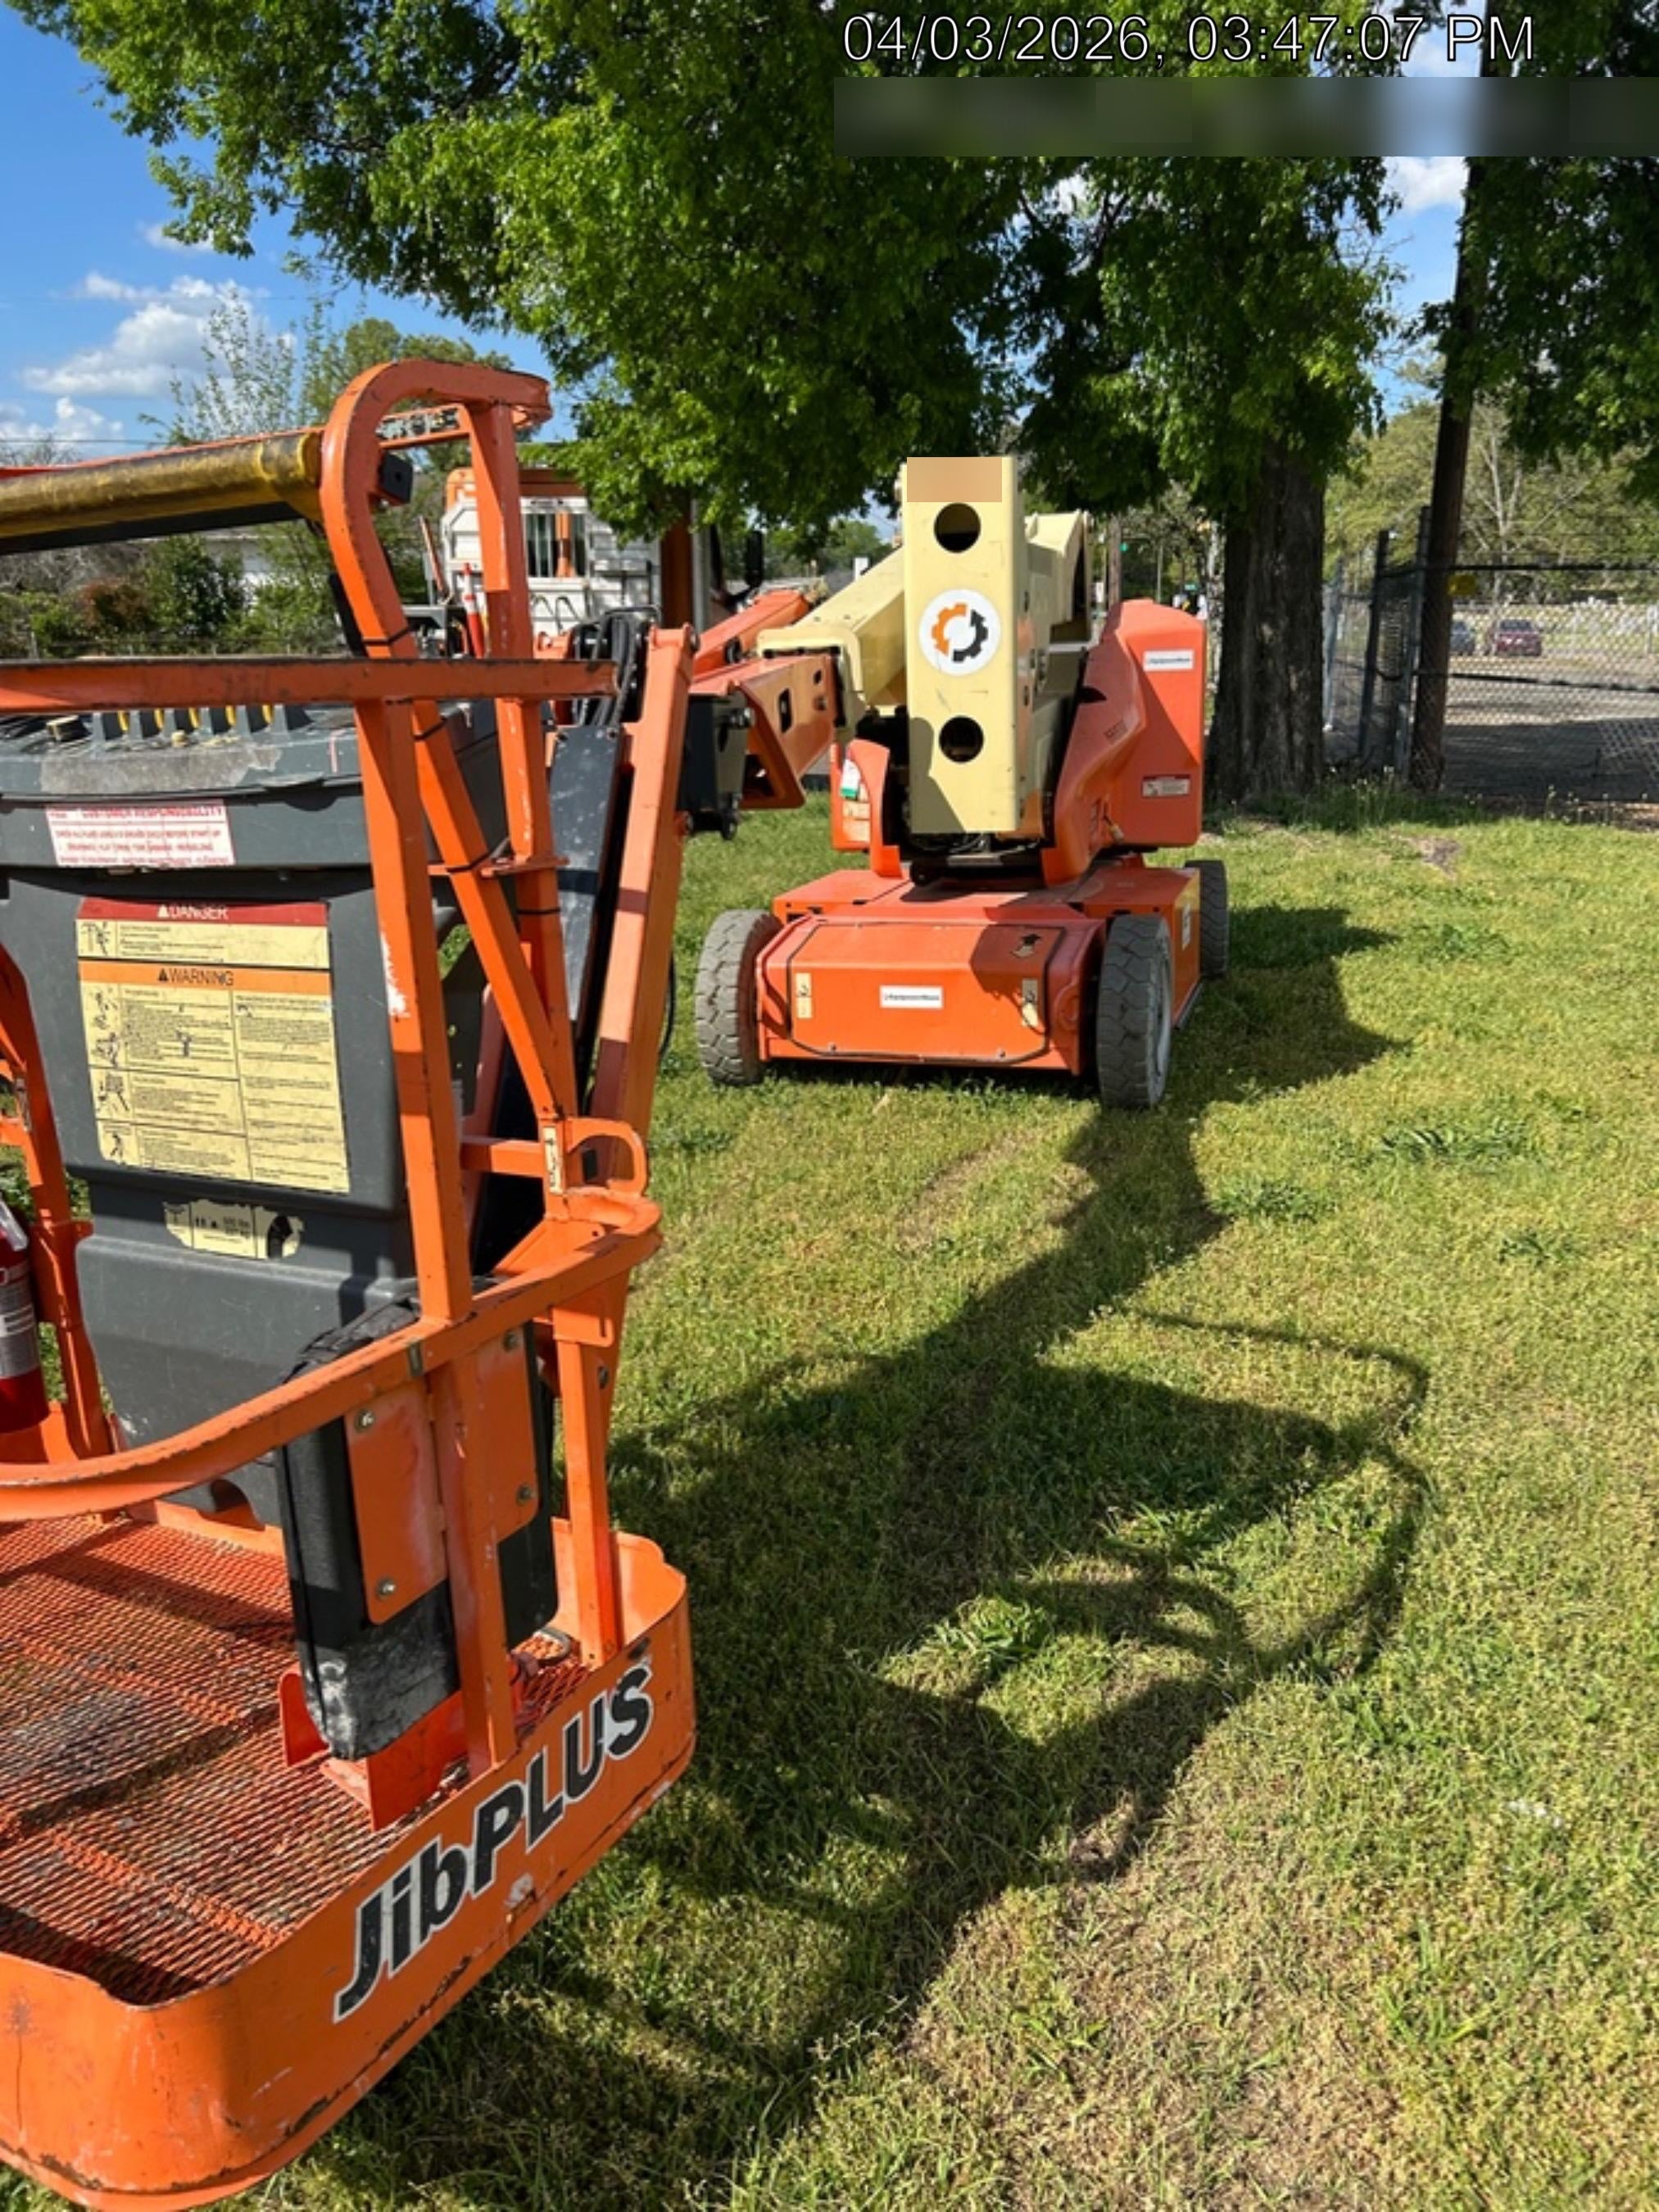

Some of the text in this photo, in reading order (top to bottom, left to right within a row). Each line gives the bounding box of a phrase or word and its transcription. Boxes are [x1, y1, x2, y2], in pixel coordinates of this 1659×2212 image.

[169, 903, 229, 920] DANGER
[168, 968, 234, 986] WARNING
[333, 1663, 654, 2024] JibPLUS
